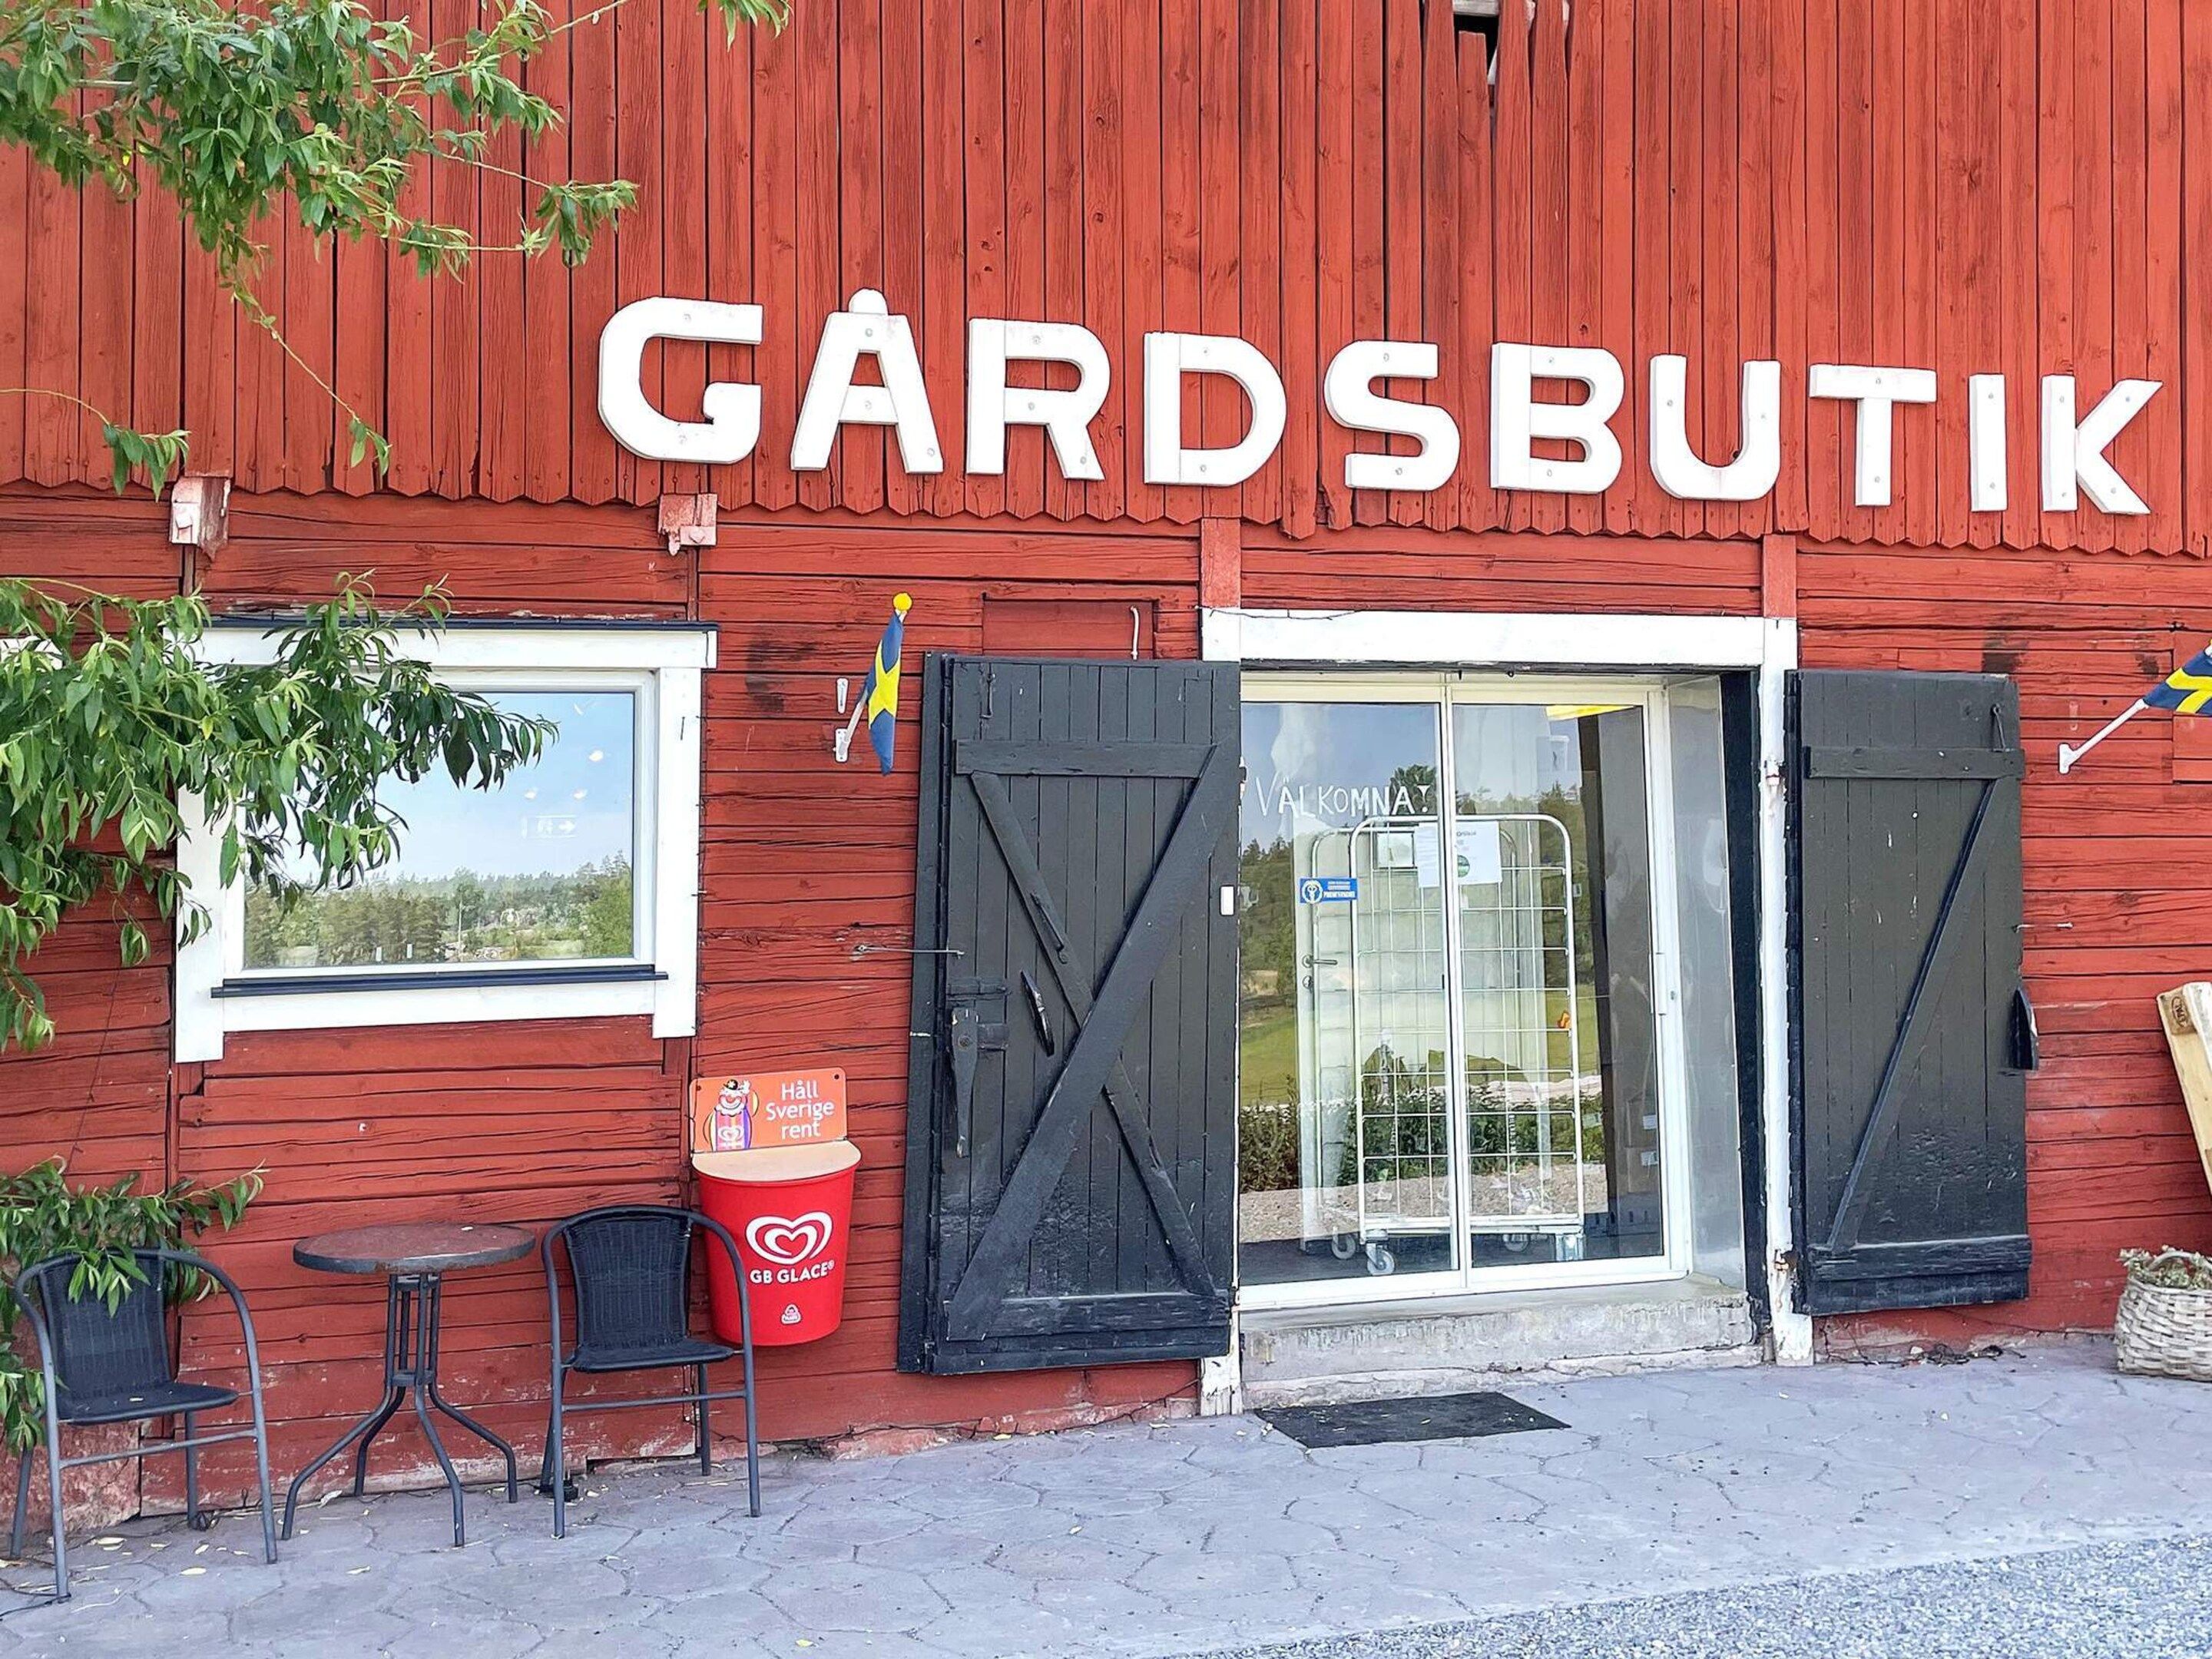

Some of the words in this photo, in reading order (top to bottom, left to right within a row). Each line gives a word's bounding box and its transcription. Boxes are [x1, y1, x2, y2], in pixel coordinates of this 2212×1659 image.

[598, 287, 2163, 515] GÅRDSBUTIK
[1256, 771, 1431, 819] VÄLKOMNA!
[780, 1080, 819, 1101] Håll
[765, 1100, 835, 1121] Sverige
[780, 1121, 821, 1140] rent
[750, 1269, 773, 1284] GB
